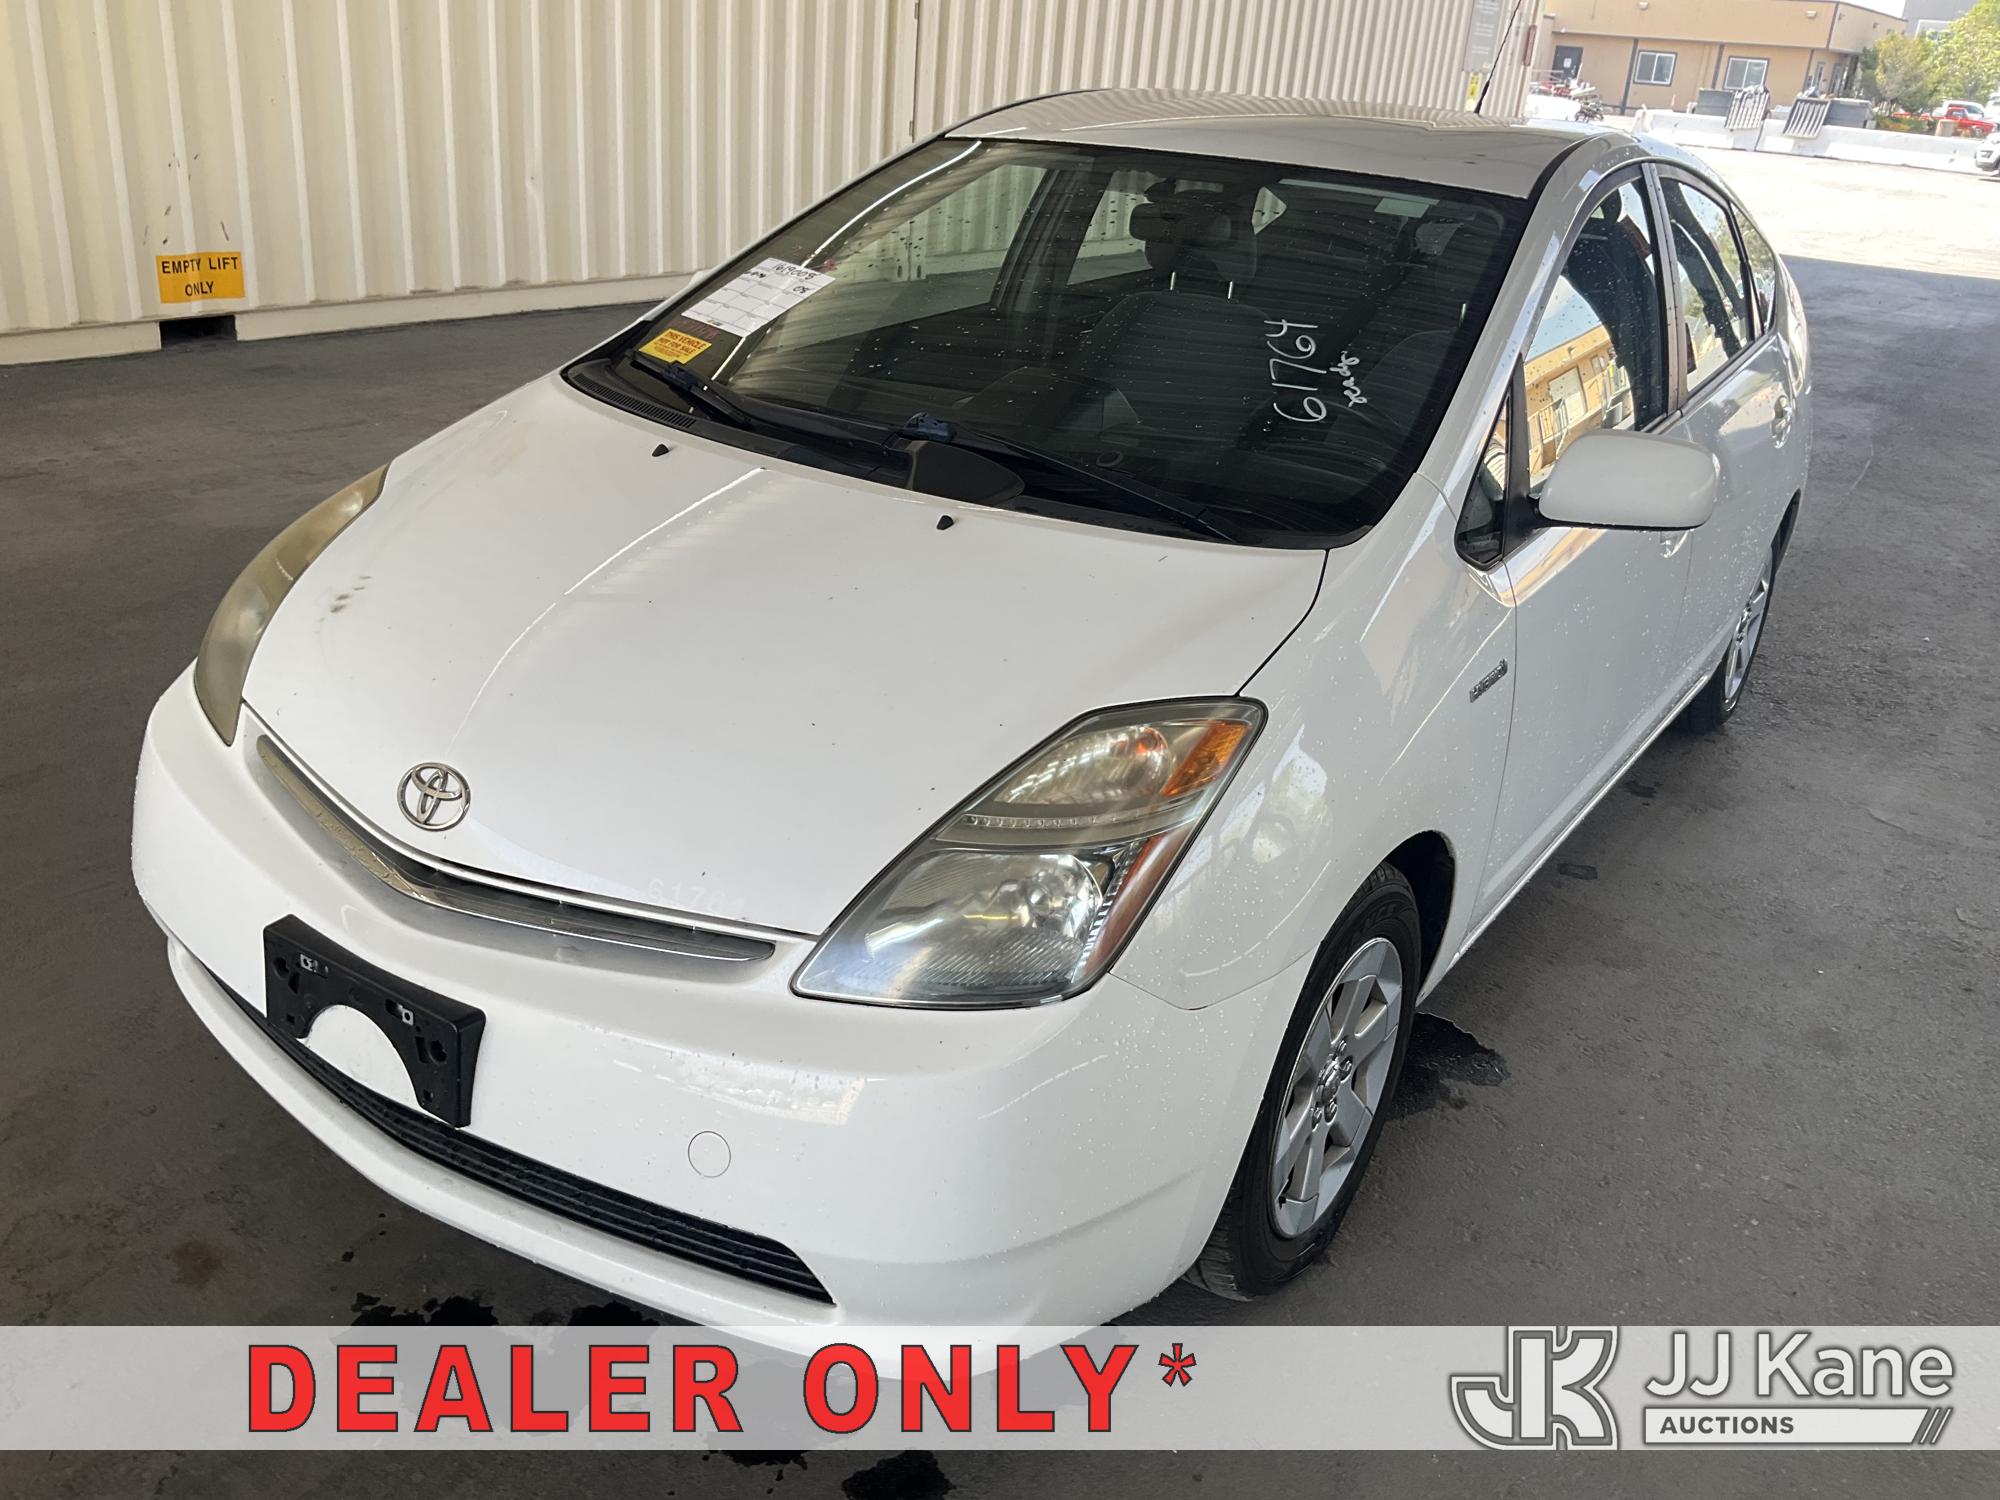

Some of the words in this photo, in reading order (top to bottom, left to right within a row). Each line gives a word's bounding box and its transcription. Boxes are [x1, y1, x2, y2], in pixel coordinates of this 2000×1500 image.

[161, 258, 201, 274] EMPTY
[208, 256, 238, 270] LIFT
[184, 281, 214, 296] ONLY
[679, 336, 707, 350] VEHICLE
[1263, 319, 1327, 422] 61764
